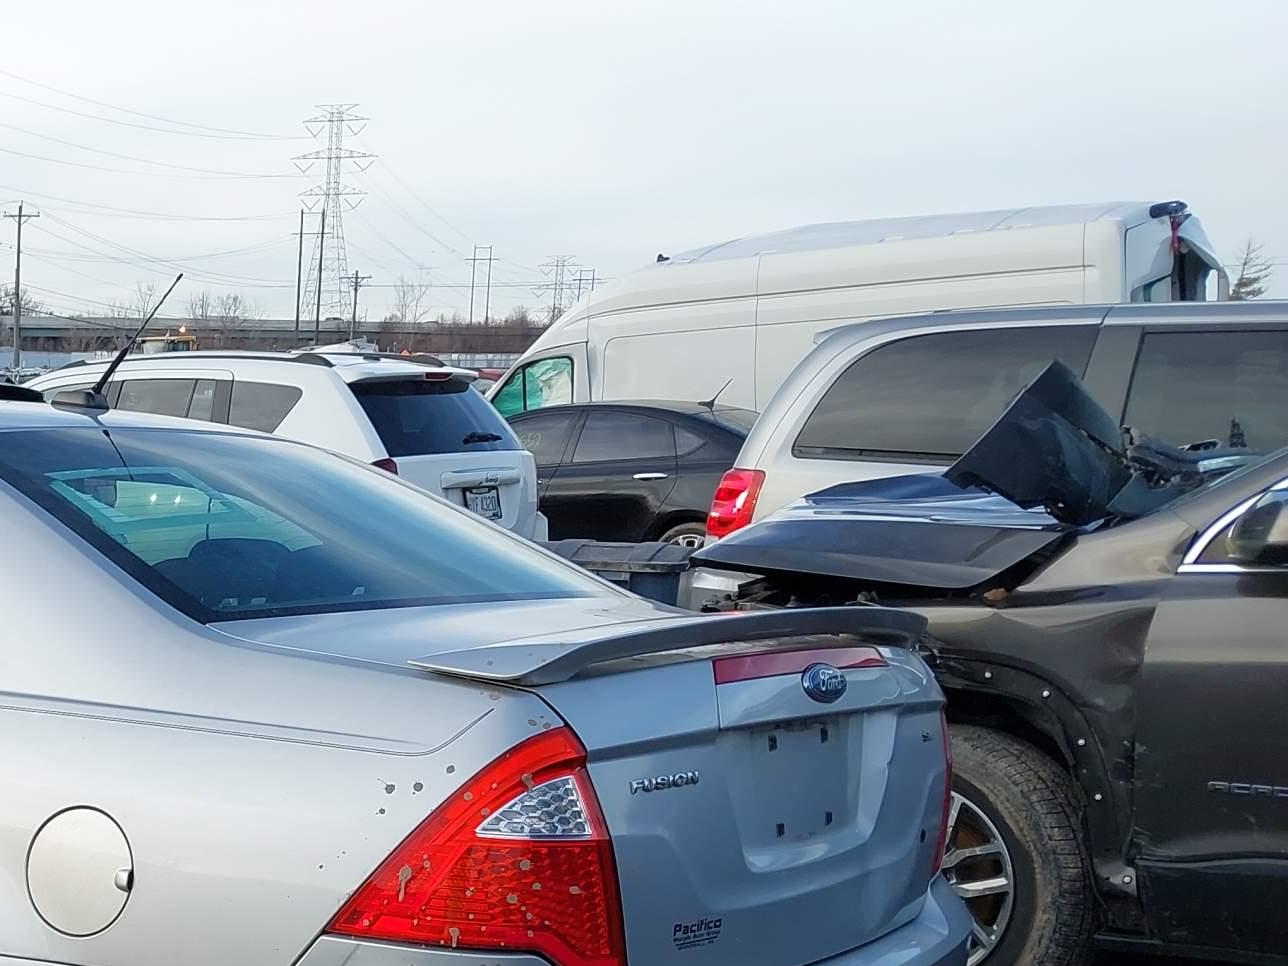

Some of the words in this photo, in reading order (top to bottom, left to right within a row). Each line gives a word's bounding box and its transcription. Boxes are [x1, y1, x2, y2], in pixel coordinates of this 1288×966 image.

[819, 669, 842, 691] Ford
[629, 771, 699, 795] FUSION
[673, 917, 722, 937] Pacifico
